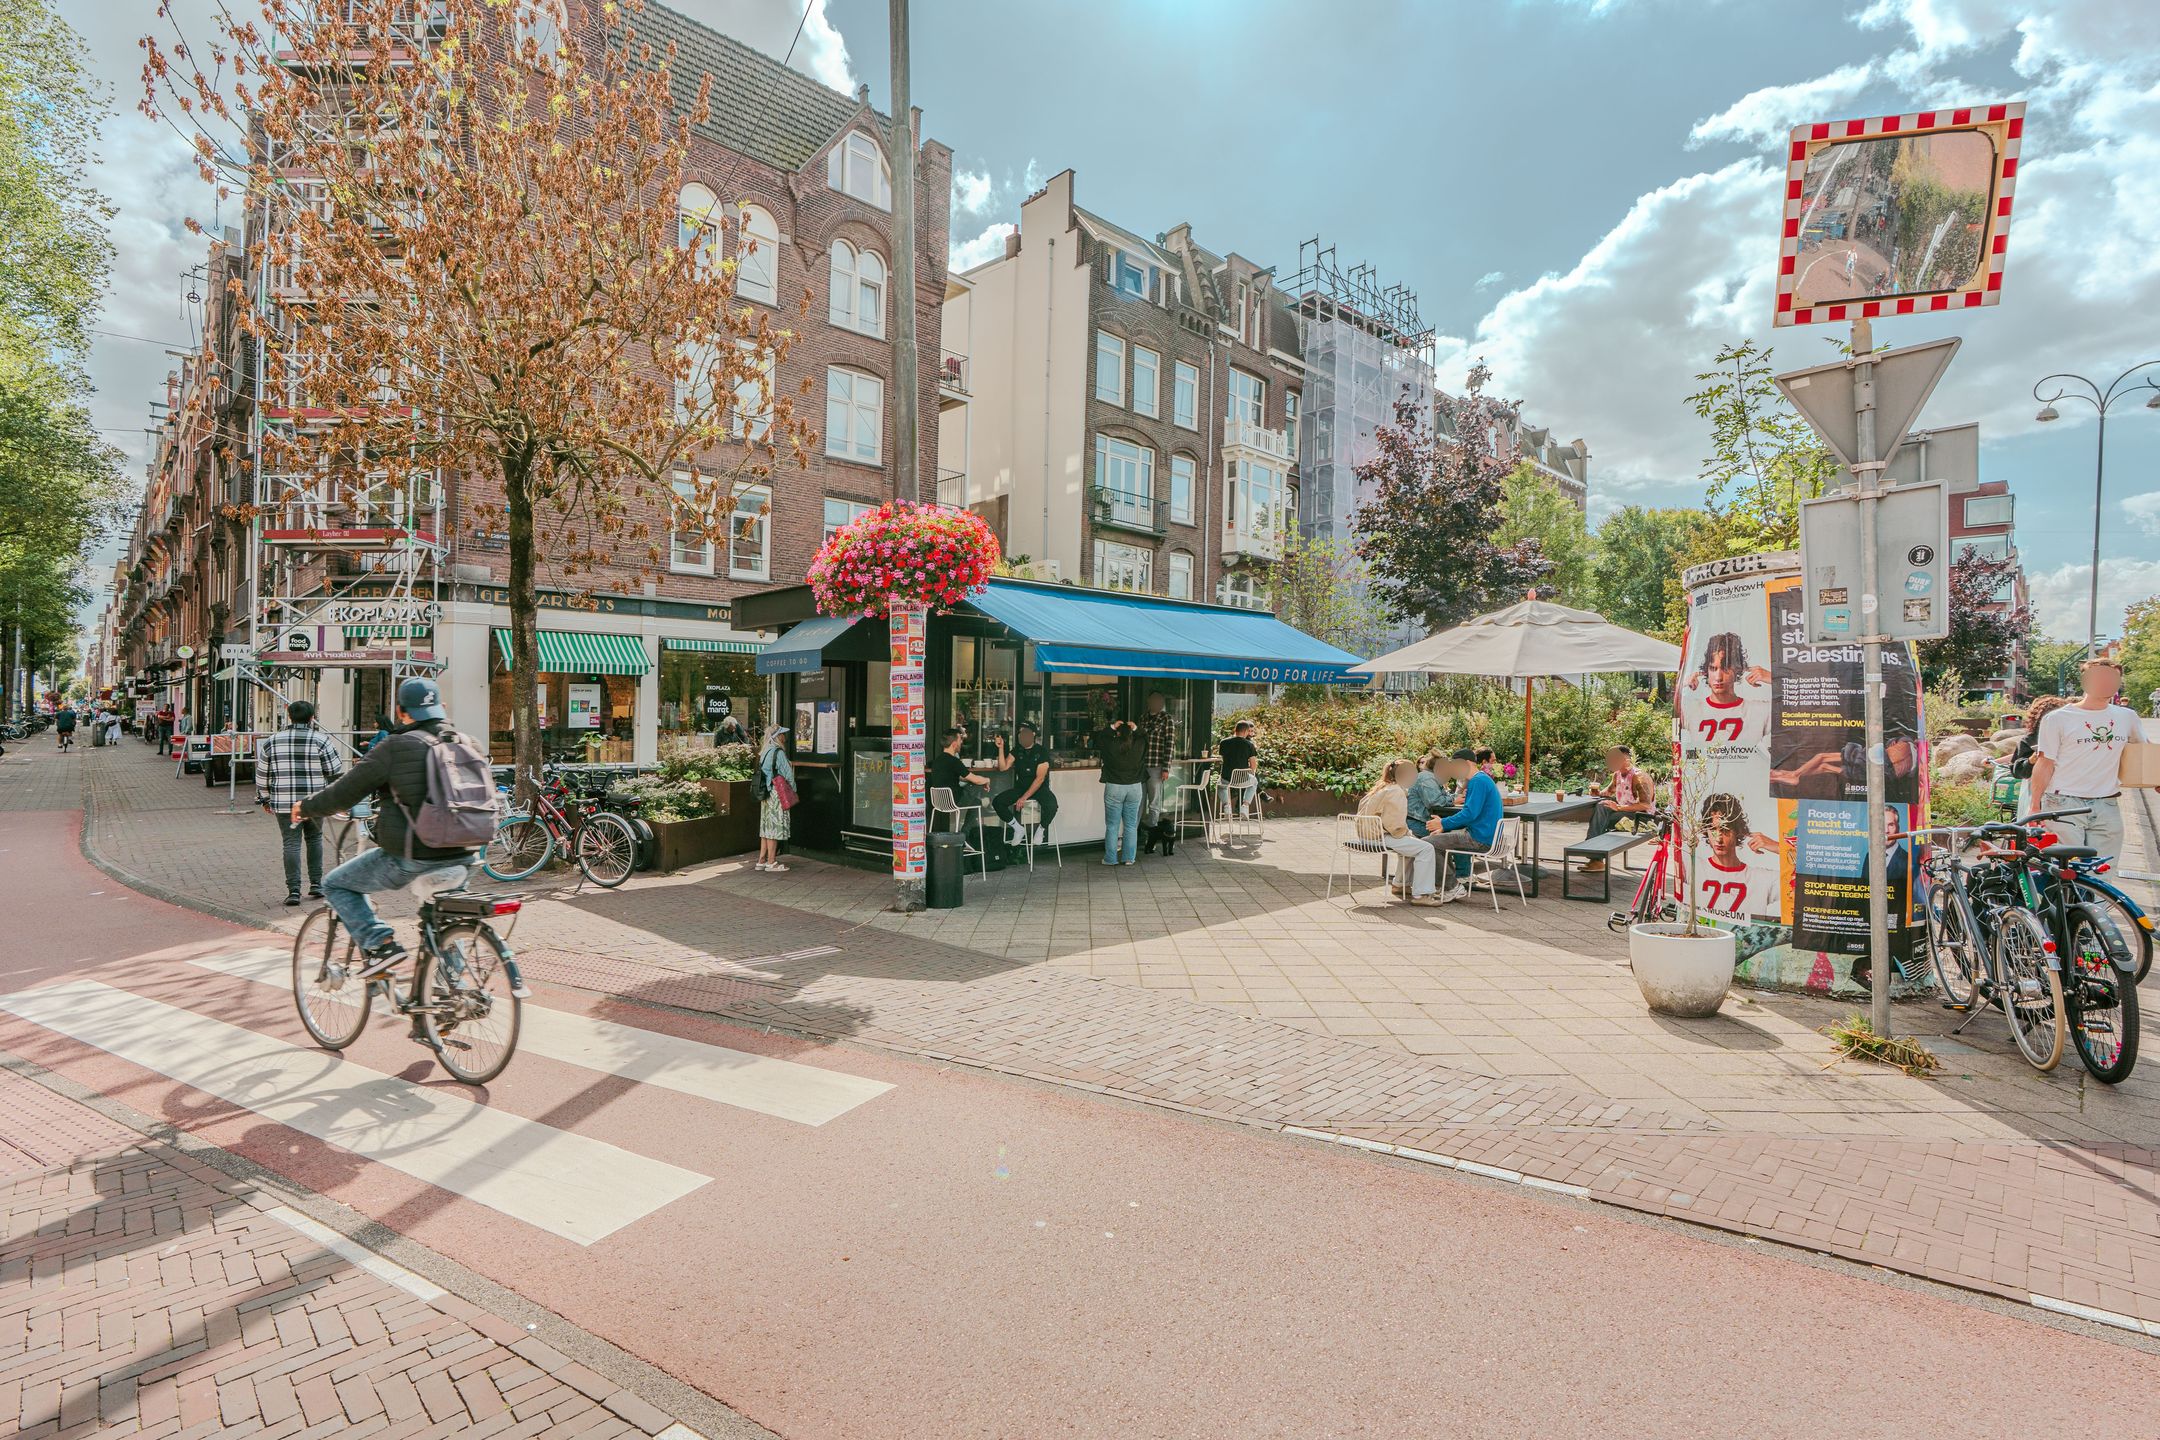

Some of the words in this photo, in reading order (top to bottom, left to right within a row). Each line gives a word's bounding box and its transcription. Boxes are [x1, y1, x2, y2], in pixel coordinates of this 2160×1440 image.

[1734, 583, 1756, 593] Know
[766, 659, 787, 667] COFFEE
[799, 657, 808, 665] GO
[1243, 666, 1279, 680] FOOD
[1284, 669, 1308, 681] FOR
[1312, 671, 1335, 682] LIFE
[958, 676, 1009, 690] IKARIA
[709, 699, 727, 707] food
[707, 706, 730, 715] marqt
[1781, 719, 1819, 727] Sanction
[1820, 719, 1842, 727] Israel
[1698, 718, 1744, 741] 77
[1730, 746, 1753, 754] Know
[1808, 809, 1836, 819] Roep
[1838, 810, 1852, 819] de
[1807, 820, 1841, 828] macht
[1842, 820, 1857, 829] ter
[1832, 851, 1860, 859] bindend.
[1804, 881, 1826, 889] STOP
[1702, 880, 1747, 912] 77
[1804, 888, 1840, 897] SANCTIES
[1840, 891, 1863, 899] TEGEN
[1803, 906, 1842, 915] ONDERNEEM
